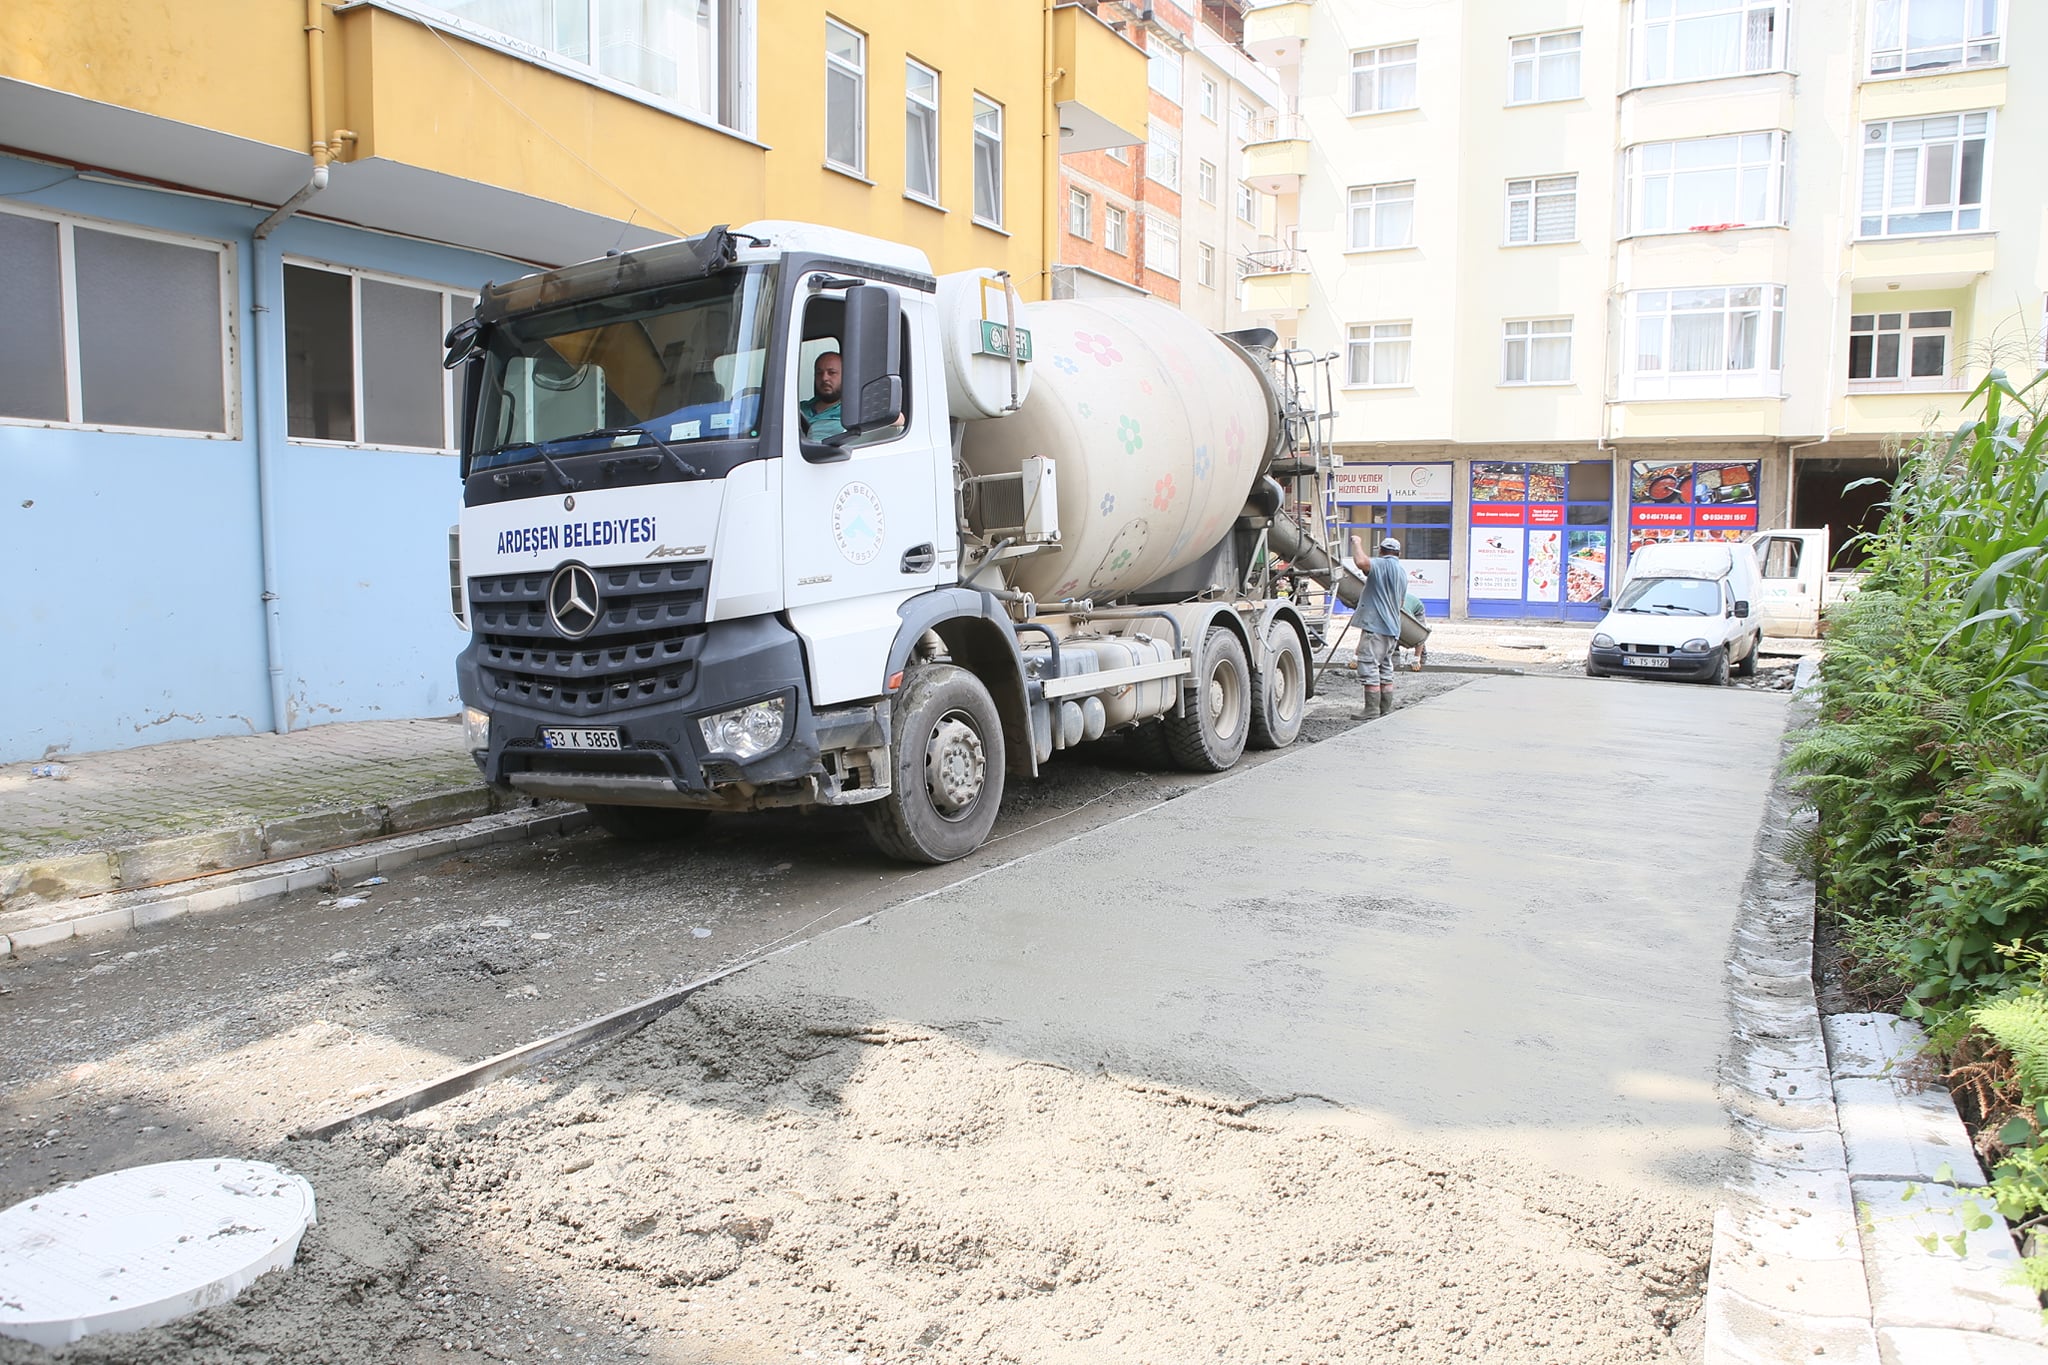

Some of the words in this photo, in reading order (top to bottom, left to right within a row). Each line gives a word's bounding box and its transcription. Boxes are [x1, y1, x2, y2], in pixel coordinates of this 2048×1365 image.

[1335, 474, 1357, 483] TOPLU
[1358, 474, 1383, 483] YEMEK
[497, 525, 559, 557] ARDEŞEN
[549, 731, 566, 747] 53
[571, 731, 581, 748] K
[585, 731, 618, 748] 5856
